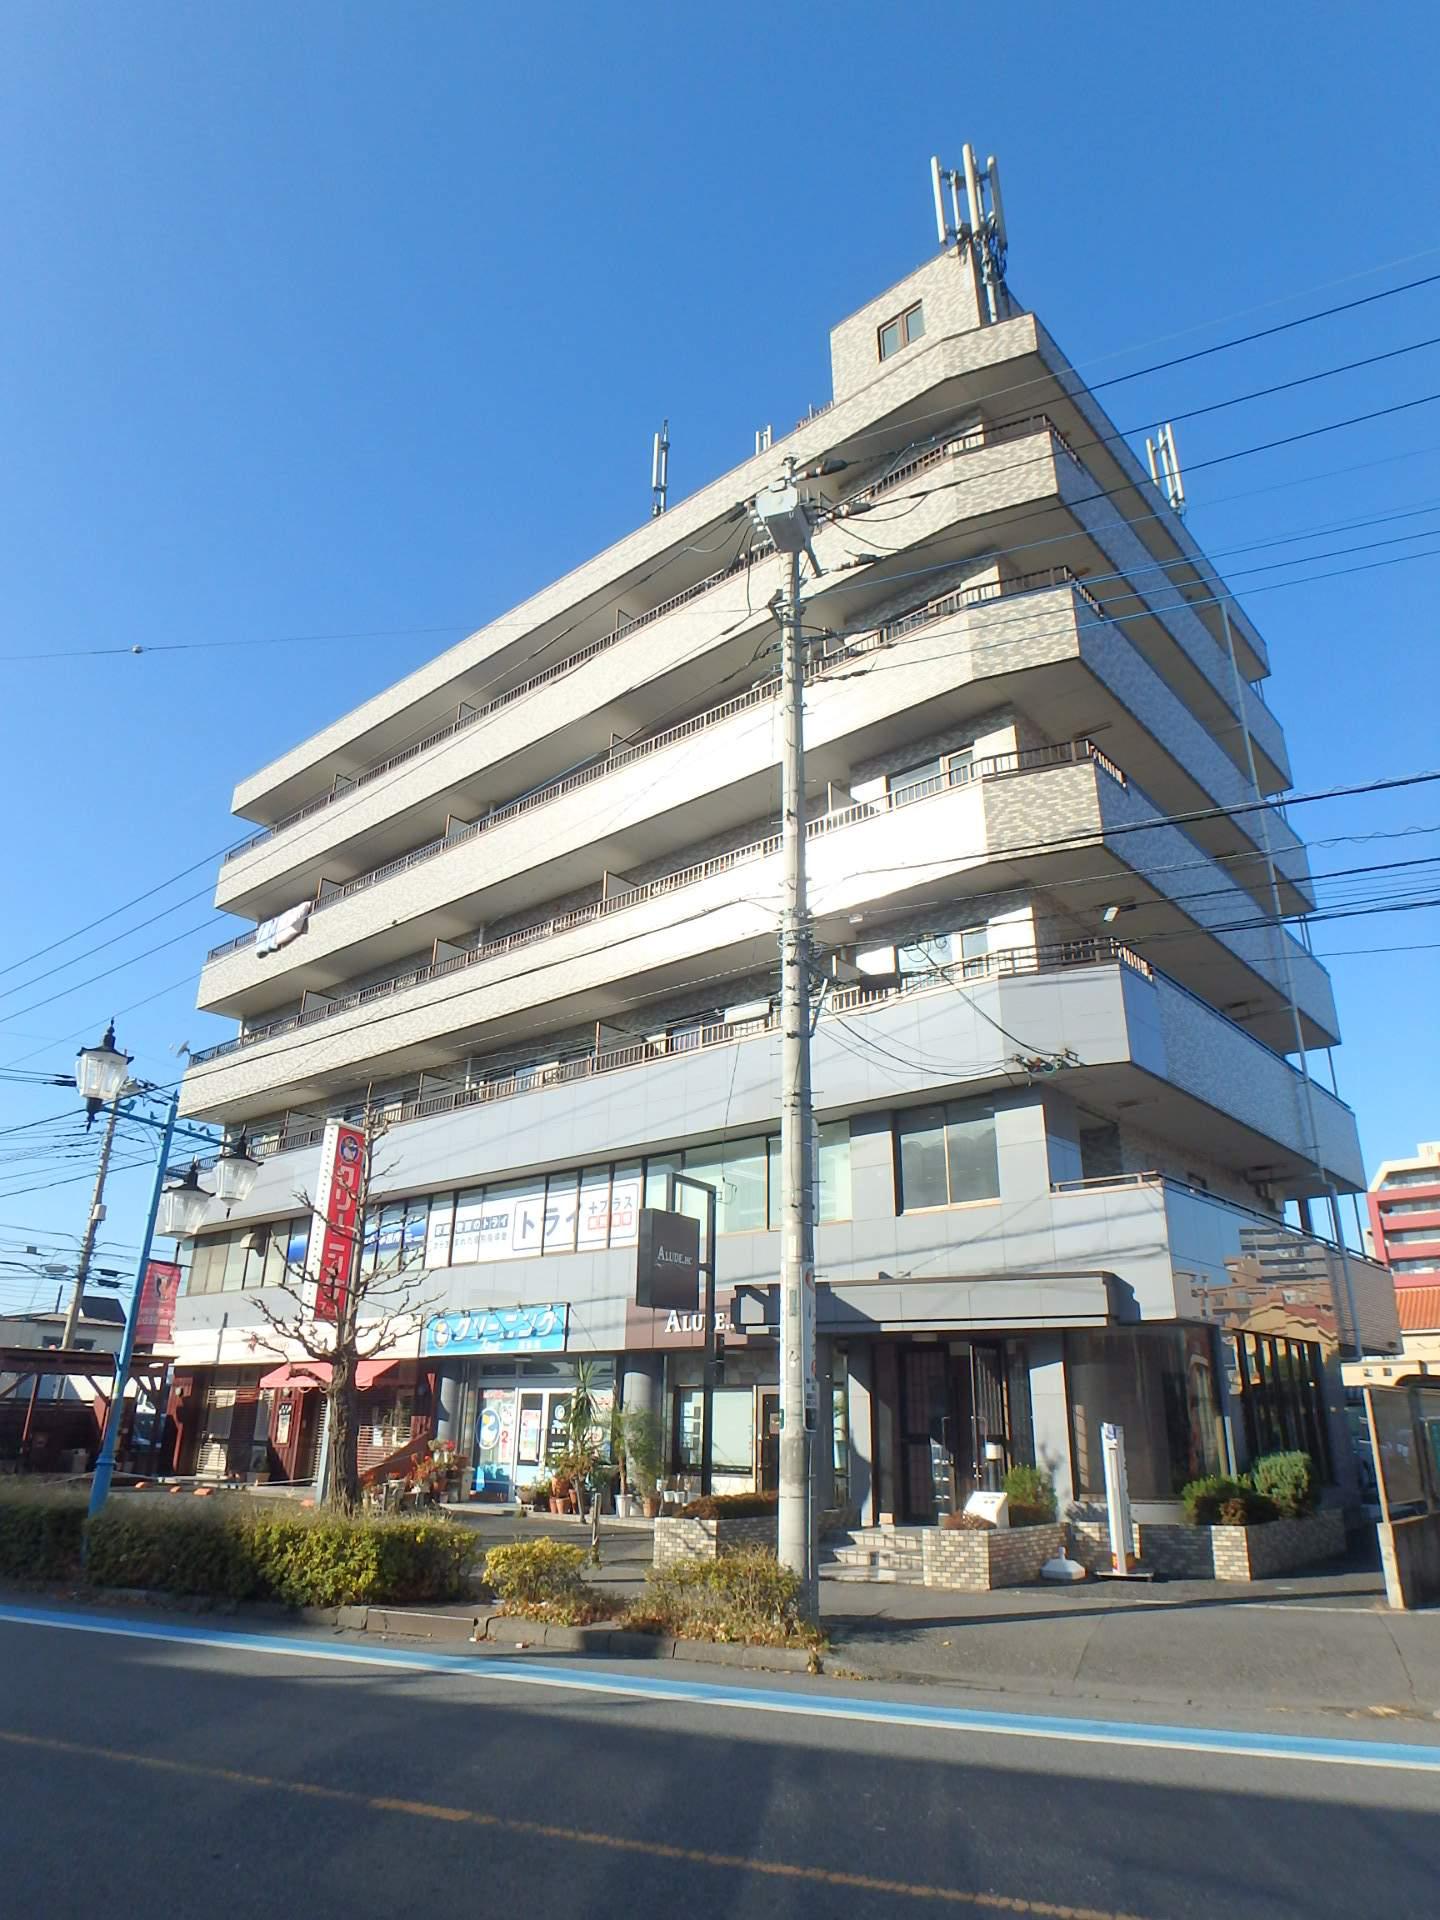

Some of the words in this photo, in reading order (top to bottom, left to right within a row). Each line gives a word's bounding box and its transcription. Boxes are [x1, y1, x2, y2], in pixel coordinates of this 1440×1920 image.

[451, 1310, 558, 1342] クリーニング
